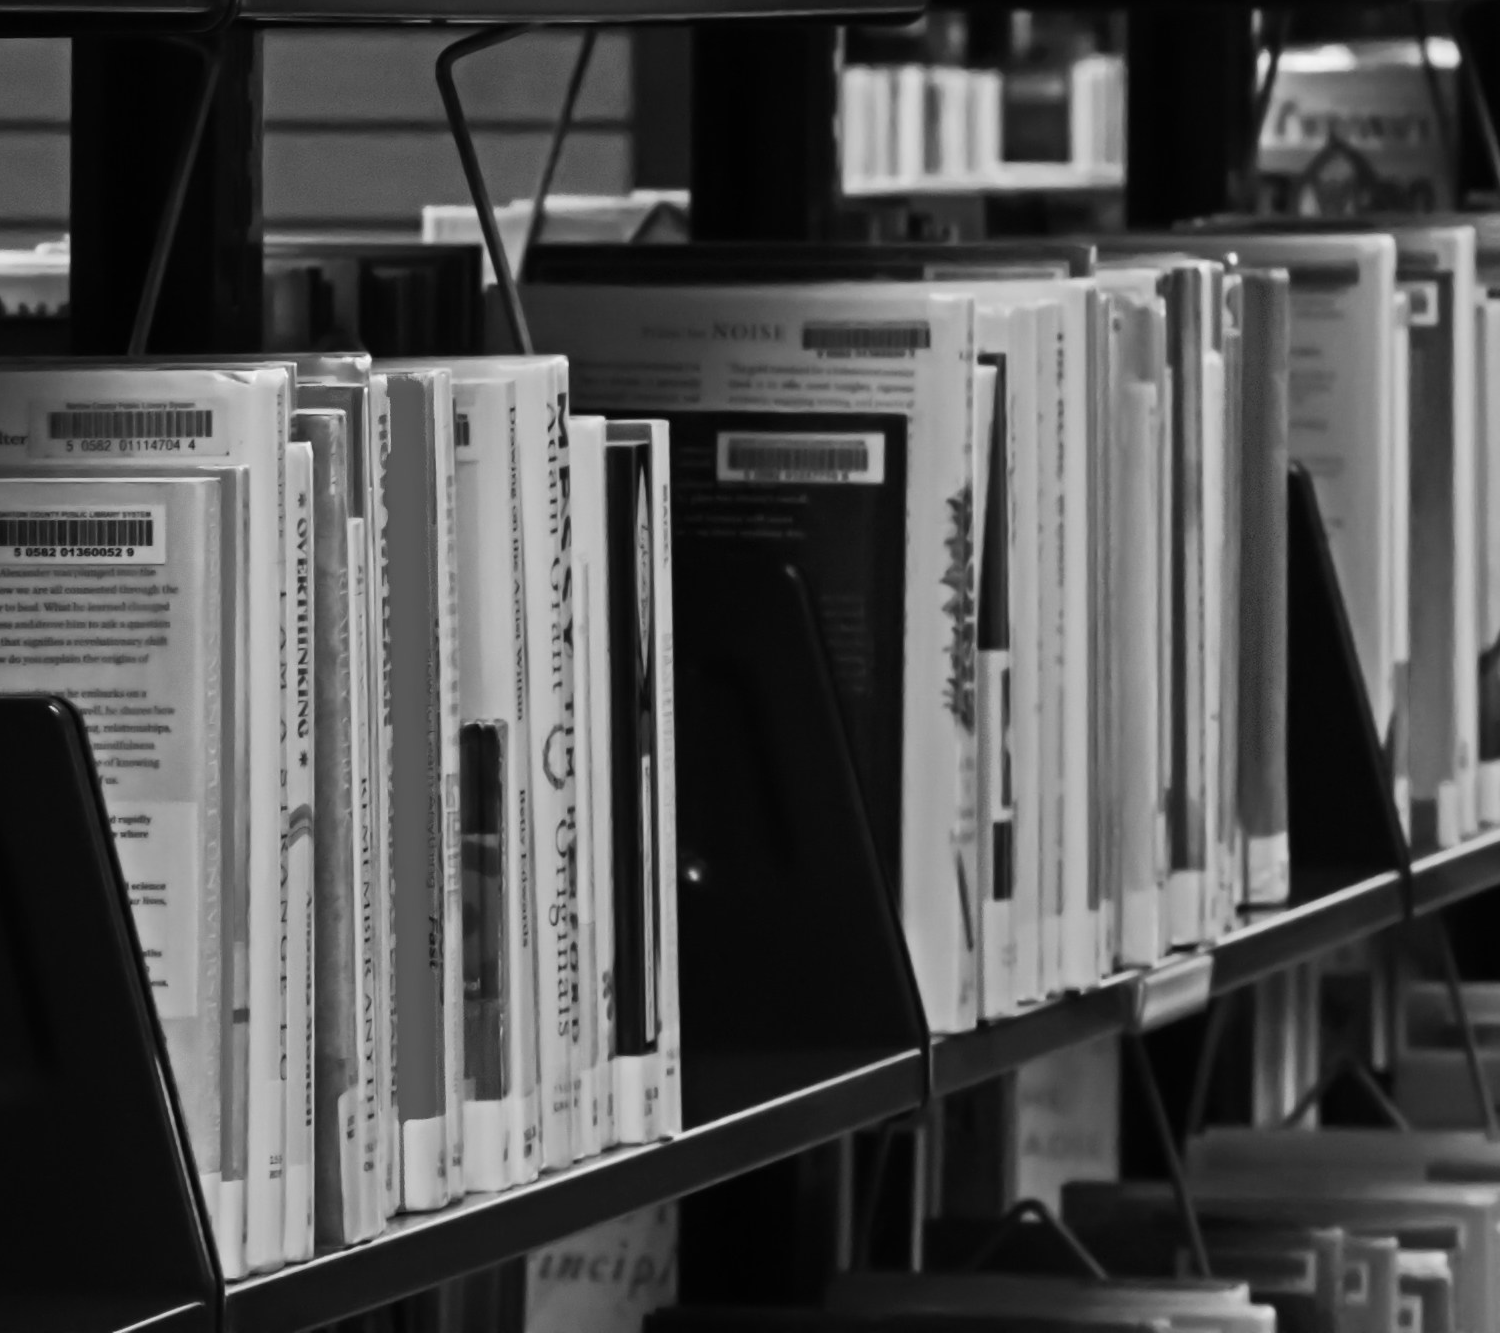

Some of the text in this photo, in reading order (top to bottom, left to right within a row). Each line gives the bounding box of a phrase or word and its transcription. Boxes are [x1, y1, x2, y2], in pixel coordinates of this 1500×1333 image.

[81, 439, 112, 451] 0582
[118, 439, 181, 451] 01114704
[187, 439, 196, 451] 4
[25, 547, 57, 558] 0582
[60, 547, 122, 558] 01360052
[126, 547, 134, 558] 9
